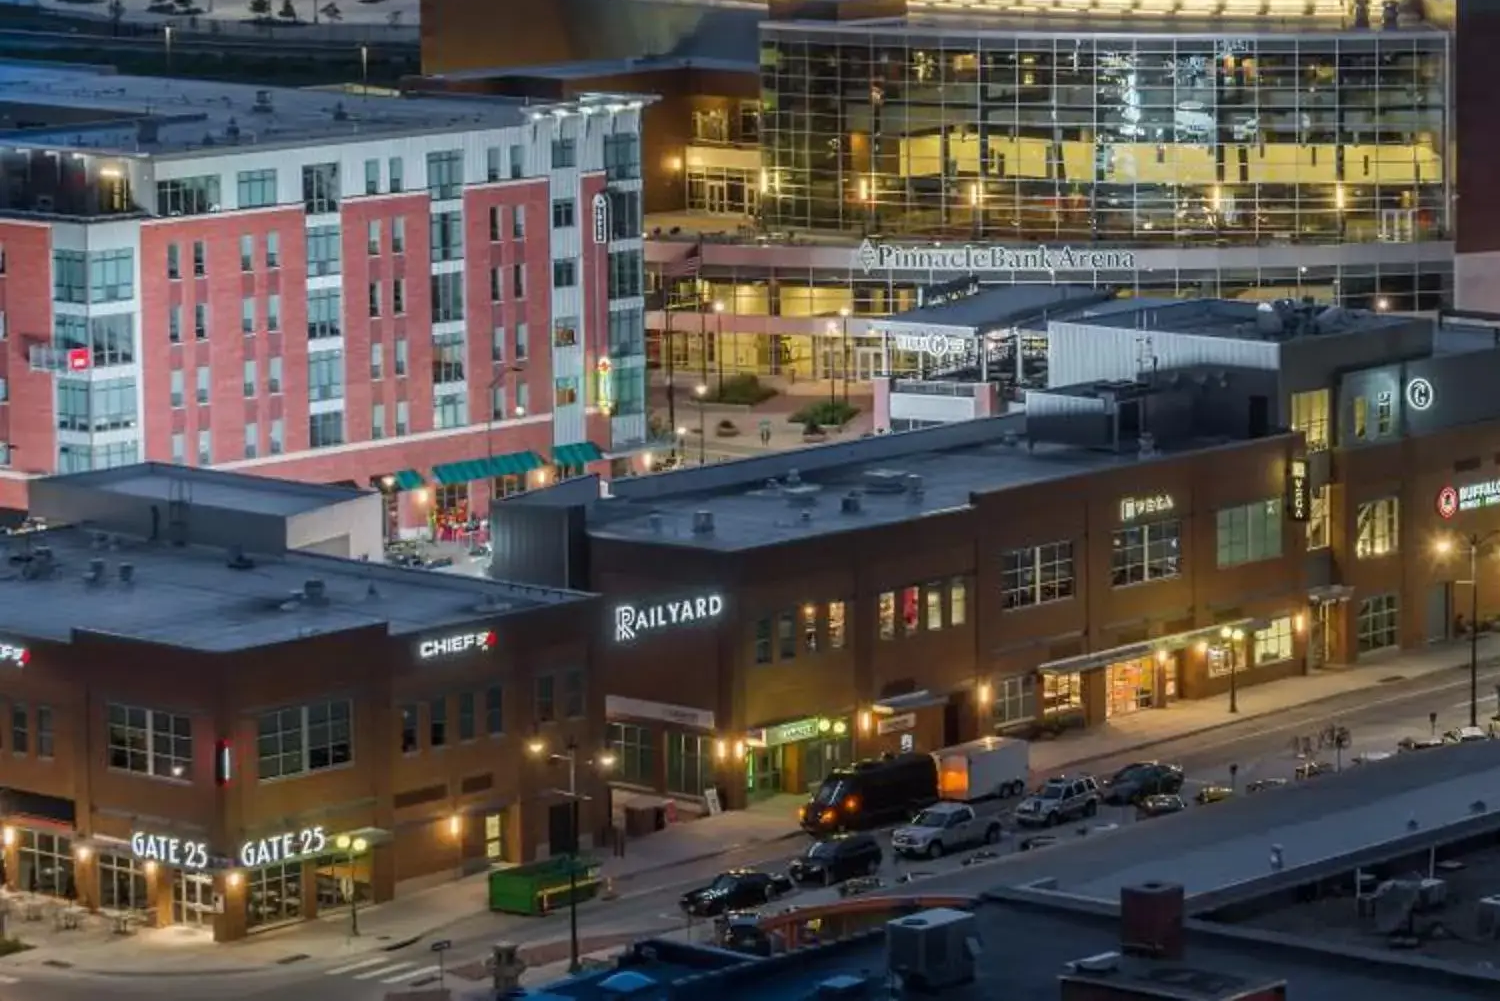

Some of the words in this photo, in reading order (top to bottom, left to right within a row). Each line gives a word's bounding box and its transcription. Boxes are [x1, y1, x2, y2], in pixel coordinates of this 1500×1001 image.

[1059, 246, 1135, 269] Arena
[614, 594, 723, 642] RAILYARD
[131, 831, 181, 865] GATE
[184, 841, 208, 869] 25
[240, 831, 296, 867] GATE
[300, 825, 326, 855] 25
